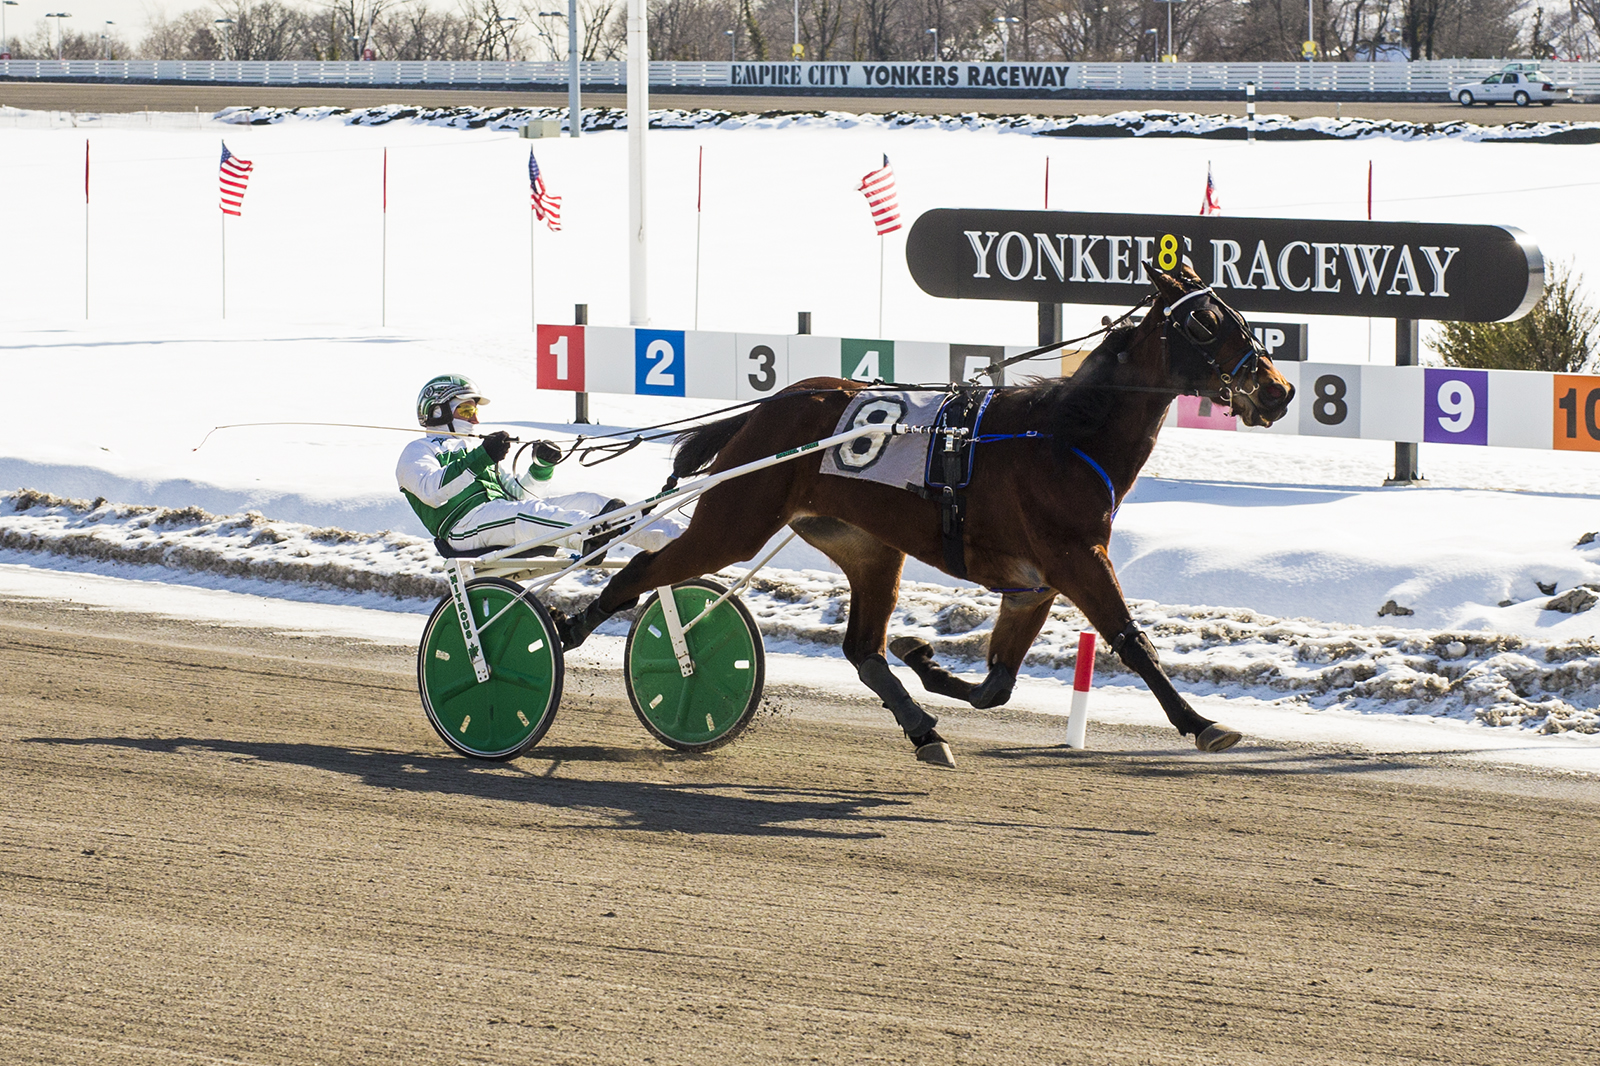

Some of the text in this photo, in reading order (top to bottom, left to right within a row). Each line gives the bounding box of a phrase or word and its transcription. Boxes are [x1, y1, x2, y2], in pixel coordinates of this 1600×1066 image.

[731, 65, 851, 85] EMPIRE CITY
[862, 65, 1070, 86] YONKERS RACEWAY
[1158, 234, 1178, 270] 8
[1209, 238, 1460, 298] RACEWAY
[549, 335, 568, 380] 1
[645, 339, 675, 386] 2
[747, 344, 777, 392] 3
[851, 350, 879, 383] 4
[1312, 374, 1347, 425] 8
[1437, 380, 1475, 433] 9
[1559, 387, 1600, 441] 10
[836, 398, 904, 470] 8
